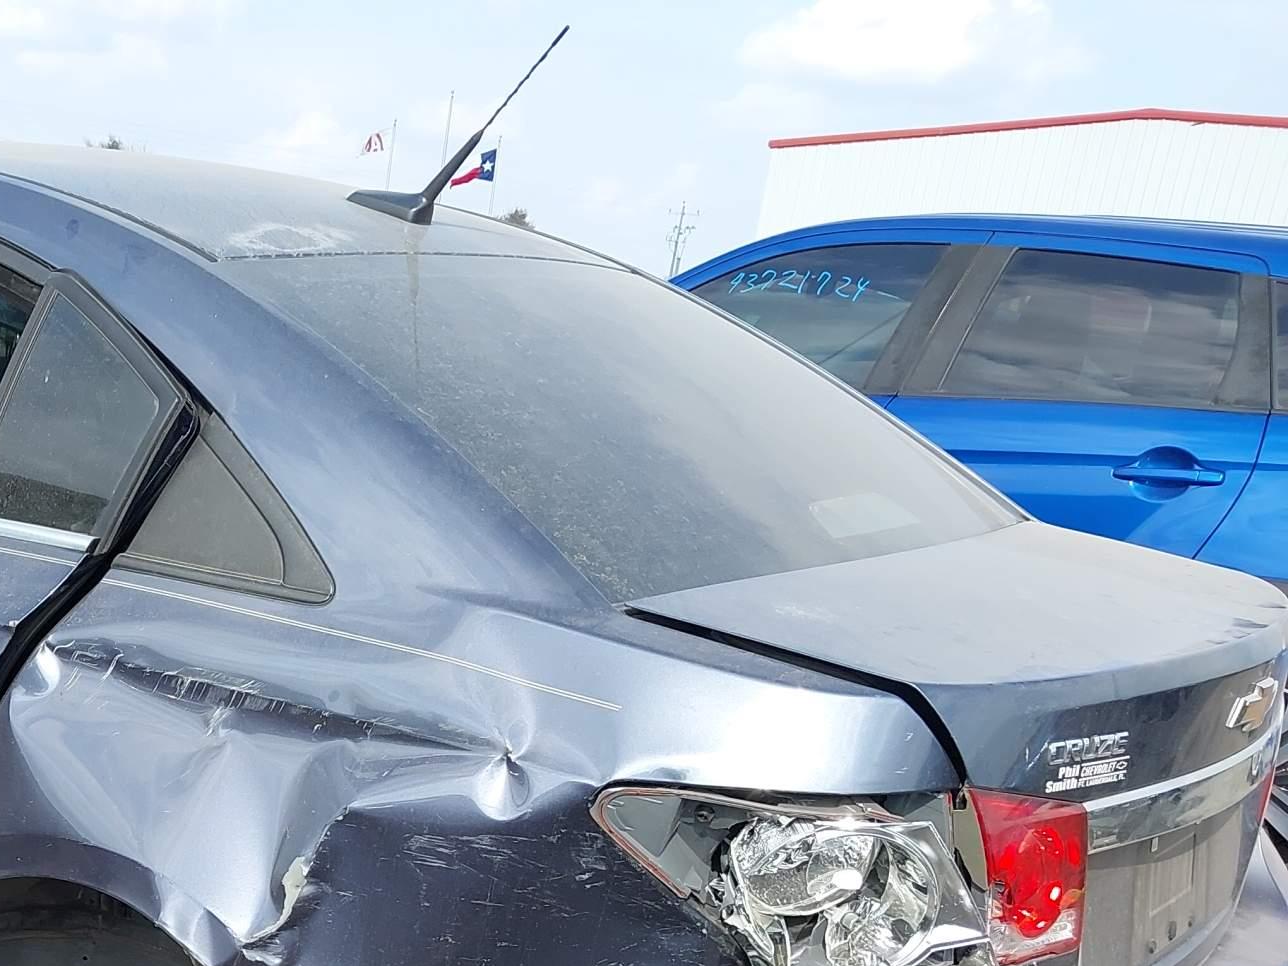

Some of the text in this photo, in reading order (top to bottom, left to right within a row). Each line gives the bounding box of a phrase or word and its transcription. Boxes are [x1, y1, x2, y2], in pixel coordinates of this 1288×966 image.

[1048, 732, 1129, 766] CRUZE
[1058, 761, 1117, 779] Phil CHEVROLET
[1045, 778, 1078, 793] Smith
